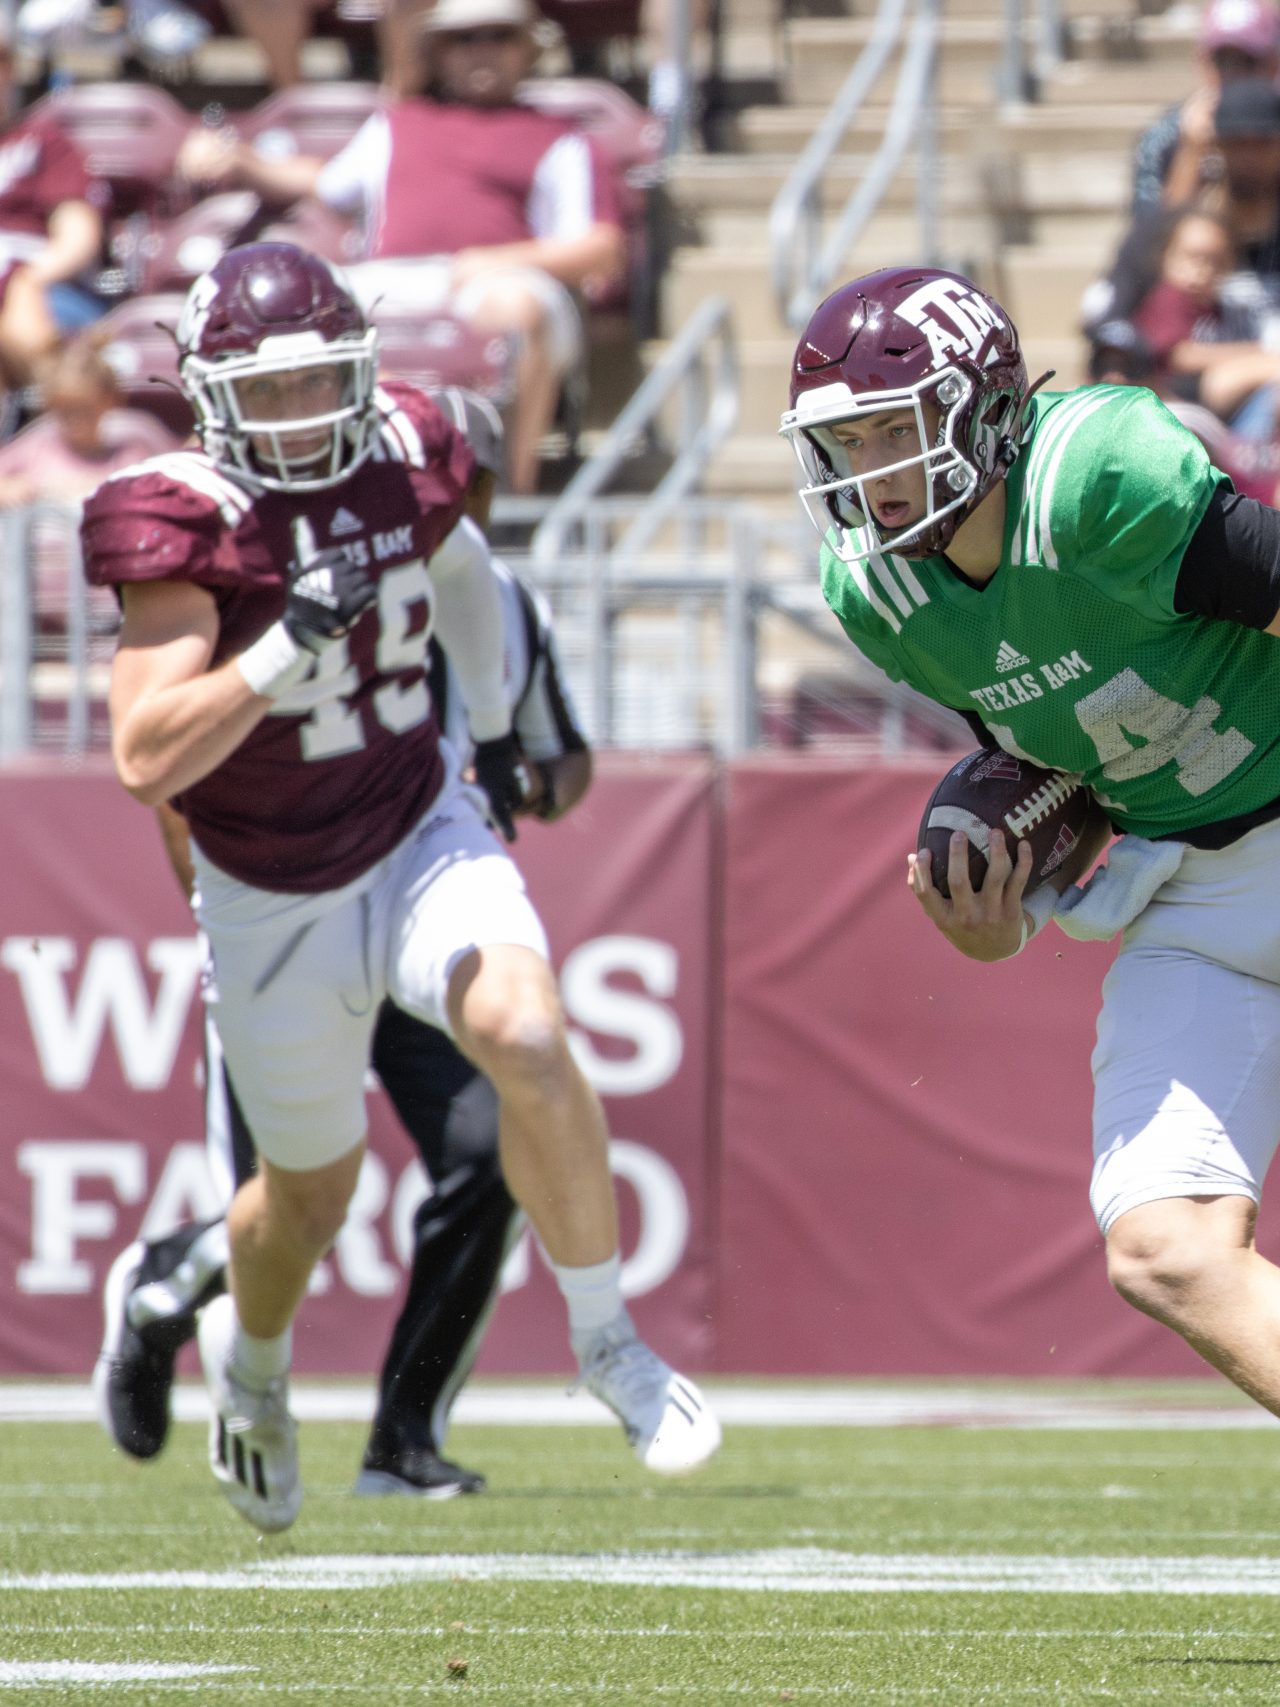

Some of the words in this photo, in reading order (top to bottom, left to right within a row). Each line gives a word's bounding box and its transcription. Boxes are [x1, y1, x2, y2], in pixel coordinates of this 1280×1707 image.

[260, 556, 437, 763] 49
[969, 672, 1044, 712] TEXAS
[1039, 649, 1093, 690] A&M
[995, 654, 1030, 673] adidas
